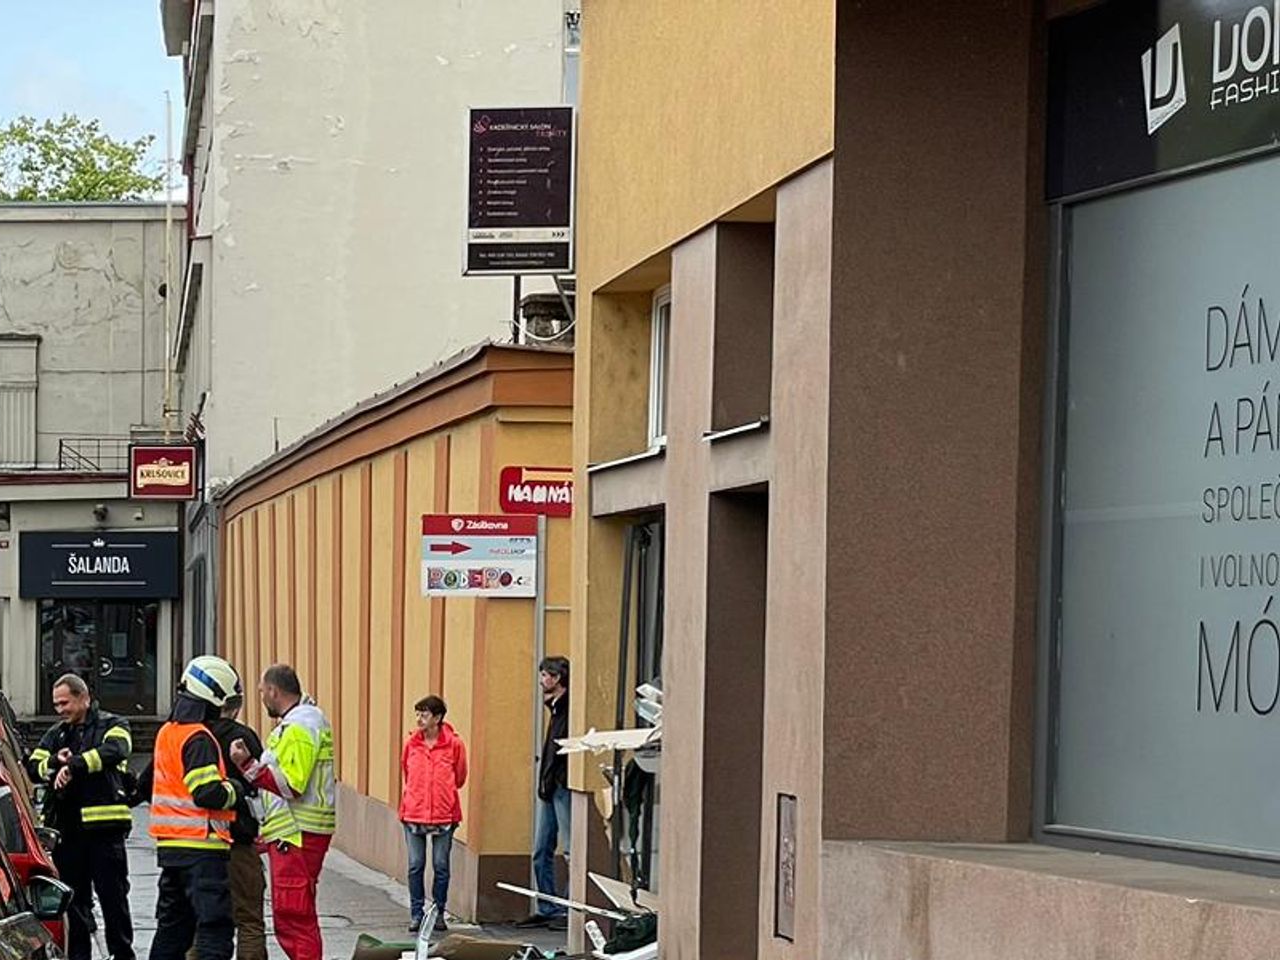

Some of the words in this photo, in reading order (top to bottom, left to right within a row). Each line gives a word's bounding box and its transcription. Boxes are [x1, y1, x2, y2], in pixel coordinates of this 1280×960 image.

[1204, 401, 1226, 459] A
[1235, 380, 1280, 455] PÁ
[68, 553, 130, 574] ŠALANDA
[1195, 595, 1280, 714] MÓ
